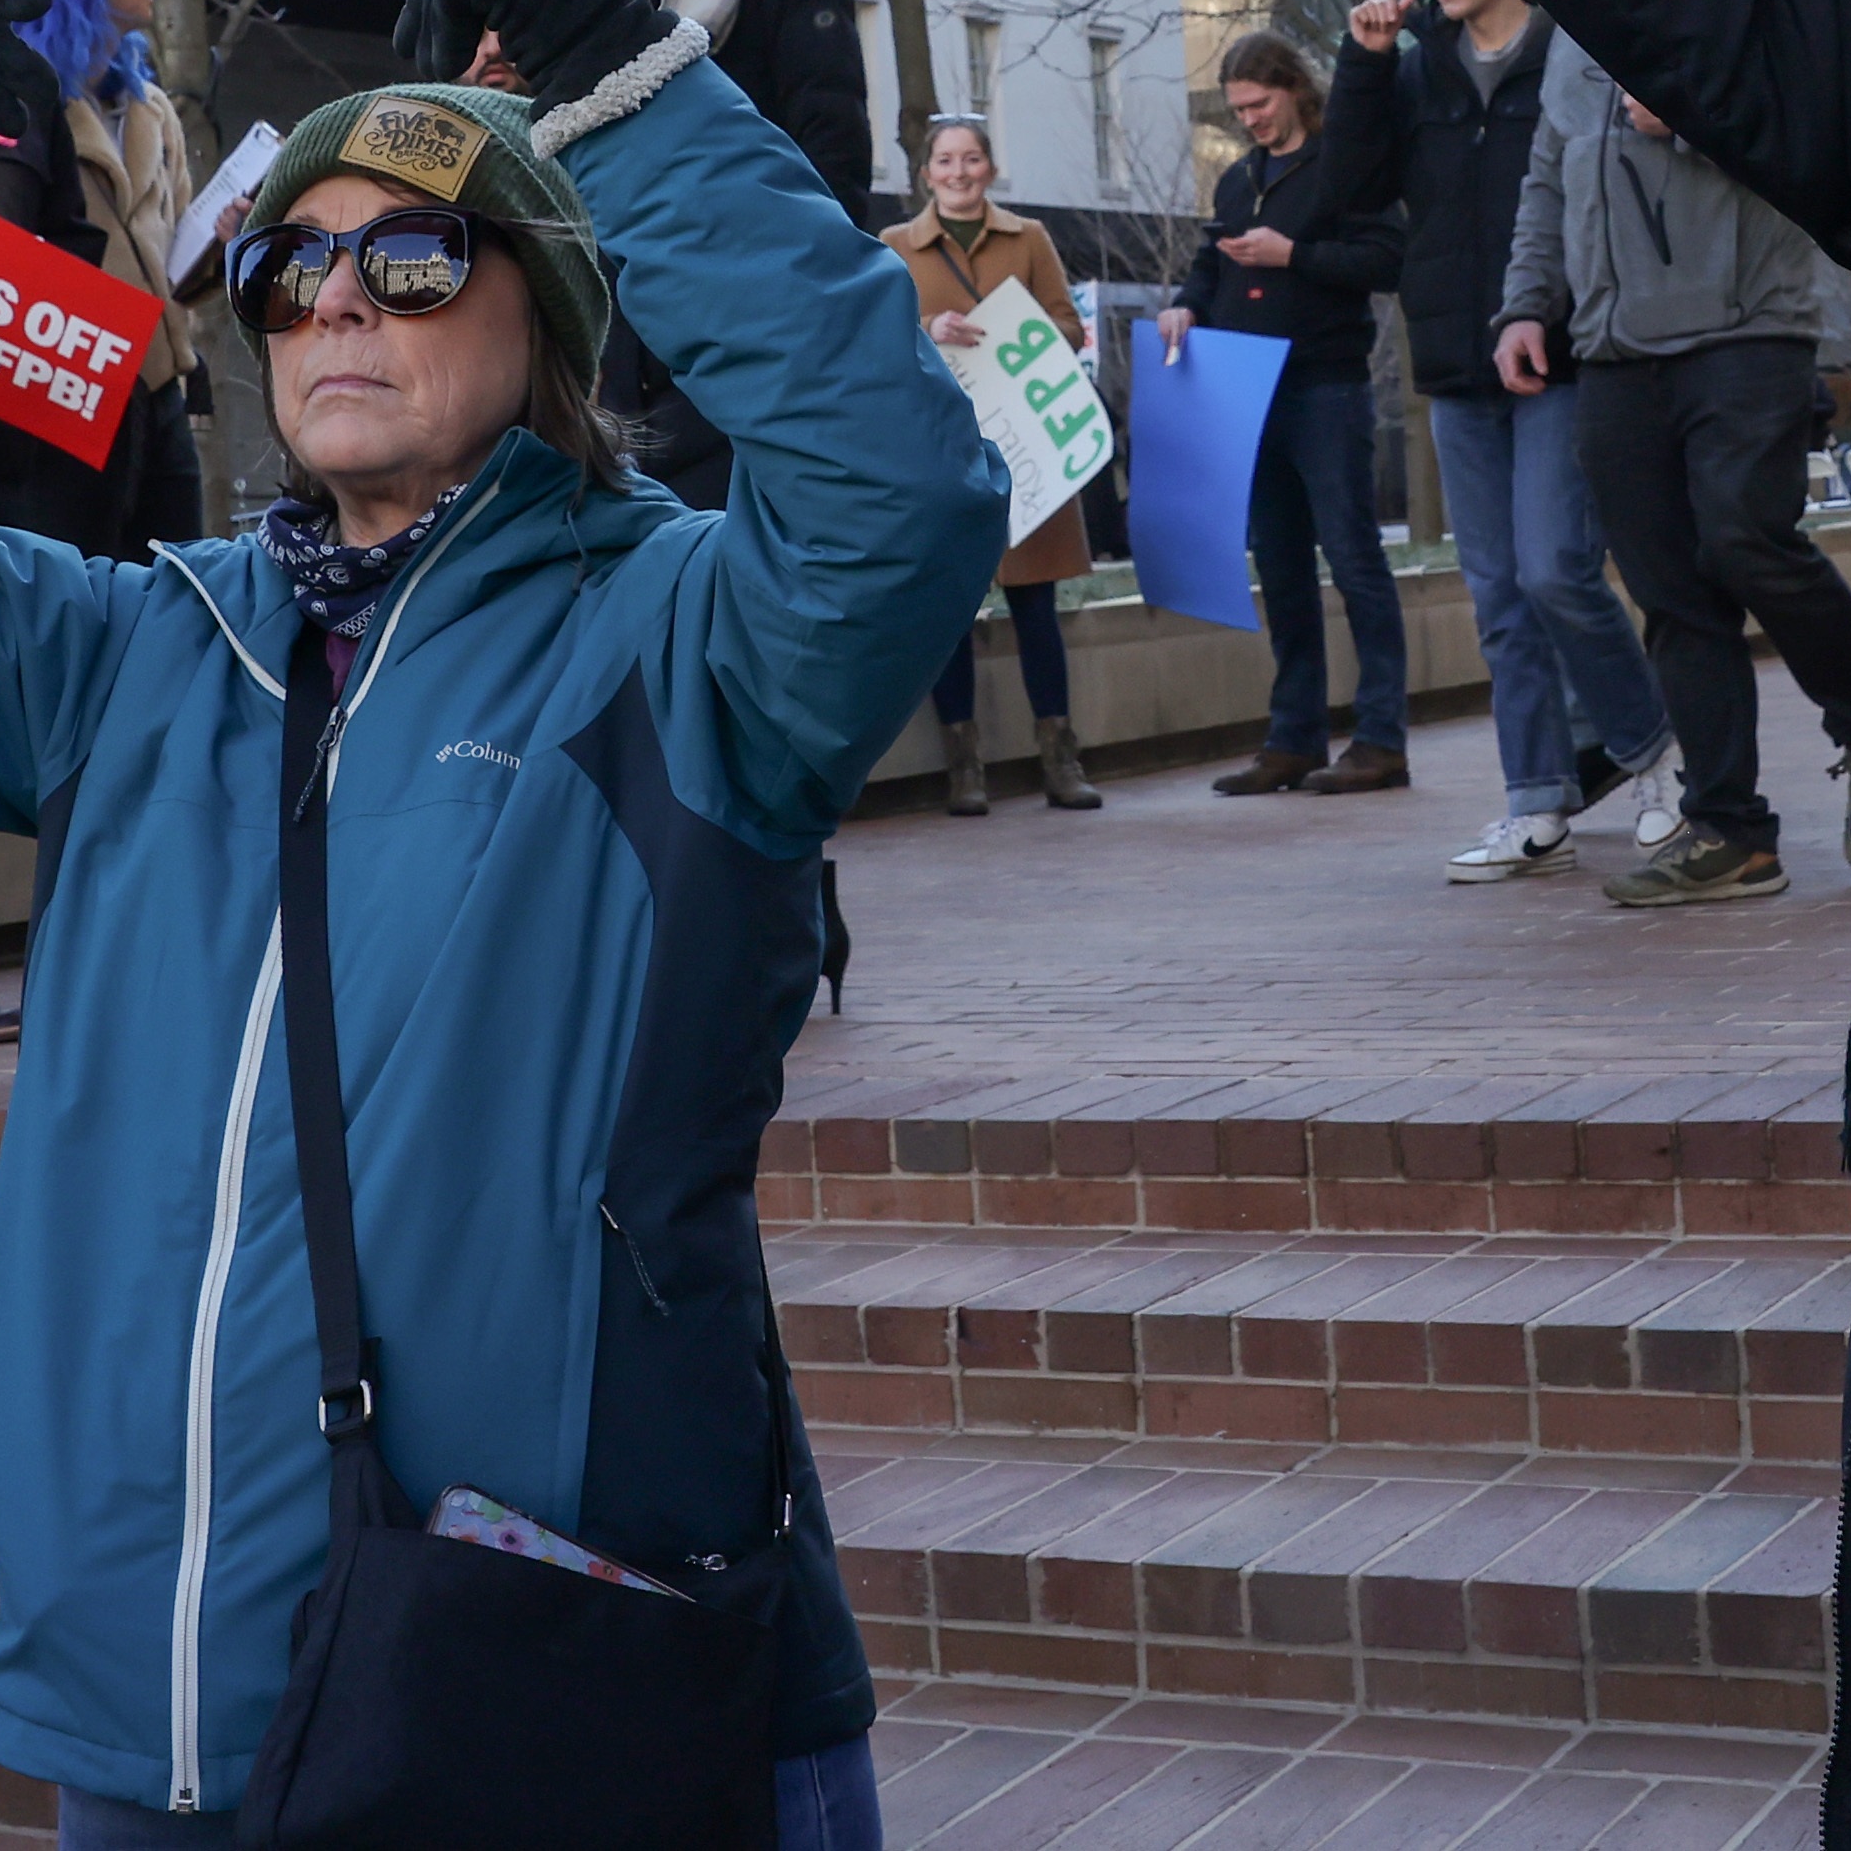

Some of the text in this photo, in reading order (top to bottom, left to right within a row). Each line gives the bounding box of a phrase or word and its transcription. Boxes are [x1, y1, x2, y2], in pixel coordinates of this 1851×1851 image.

[376, 110, 431, 135] FIVE
[384, 129, 462, 169] DIMES
[24, 301, 133, 375] OFF
[996, 319, 1105, 481] CFPB
[453, 740, 522, 771] Colum
